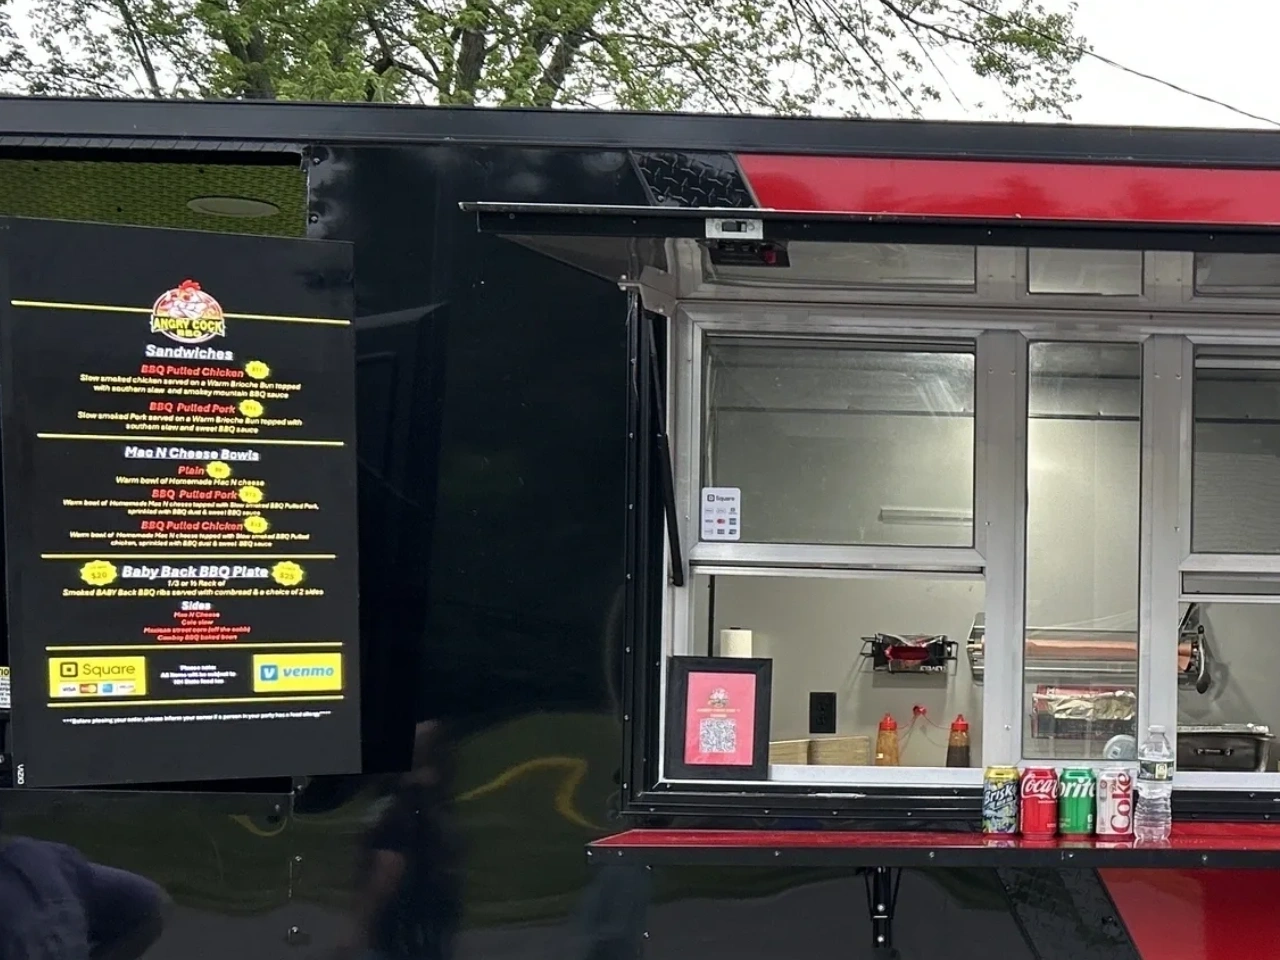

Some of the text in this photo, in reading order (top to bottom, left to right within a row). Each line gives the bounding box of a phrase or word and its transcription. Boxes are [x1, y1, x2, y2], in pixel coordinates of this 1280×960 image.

[154, 318, 222, 332] ANGRY COCK
[145, 344, 234, 361] Sandwiches
[140, 364, 165, 375] BBQ
[166, 365, 199, 376] Pulled
[201, 367, 244, 377] Chicken
[79, 373, 99, 382] Slow
[100, 375, 131, 383] smoked
[132, 376, 162, 384] chicken
[207, 379, 229, 387] Warm
[230, 380, 258, 388] Brioche
[259, 381, 274, 389] Bun
[275, 382, 301, 391] topped
[111, 385, 145, 393] southern
[212, 389, 247, 397] mountain
[248, 389, 265, 398] BBQ
[148, 401, 173, 412] BBQ
[176, 402, 211, 412] Pulled
[211, 403, 235, 413] Pork
[77, 410, 97, 419] Slow
[97, 412, 129, 420] smoked
[129, 412, 147, 420] Pork
[192, 415, 214, 423] Warm
[215, 415, 243, 424] Brioche
[244, 416, 259, 424] Bun
[125, 422, 160, 430] southern
[218, 424, 235, 433] BBQ
[124, 445, 259, 461] Mac N Cheese Bowls
[178, 466, 205, 476] Plain
[139, 476, 158, 484] bowl
[159, 476, 168, 484] of
[168, 477, 212, 485] Homemade
[213, 475, 229, 485] Mac
[151, 488, 175, 499] BBQ
[178, 489, 212, 499] Pulled
[213, 490, 237, 499] Pork
[140, 520, 164, 530] BBQ
[166, 520, 199, 530] Pulled
[201, 521, 243, 530] Chicken
[121, 565, 159, 579] Baby
[160, 565, 197, 578] Back
[199, 565, 230, 579] BBQ
[232, 565, 268, 578] Plate
[62, 588, 95, 596] Smoked
[95, 588, 117, 596] BABY
[117, 588, 136, 596] Back
[137, 588, 155, 596] BBQ
[181, 600, 211, 610] Sides
[83, 663, 136, 678] Square
[283, 667, 334, 677] venmo
[17, 763, 25, 785] VIZIO
[1111, 773, 1131, 833] Coke
